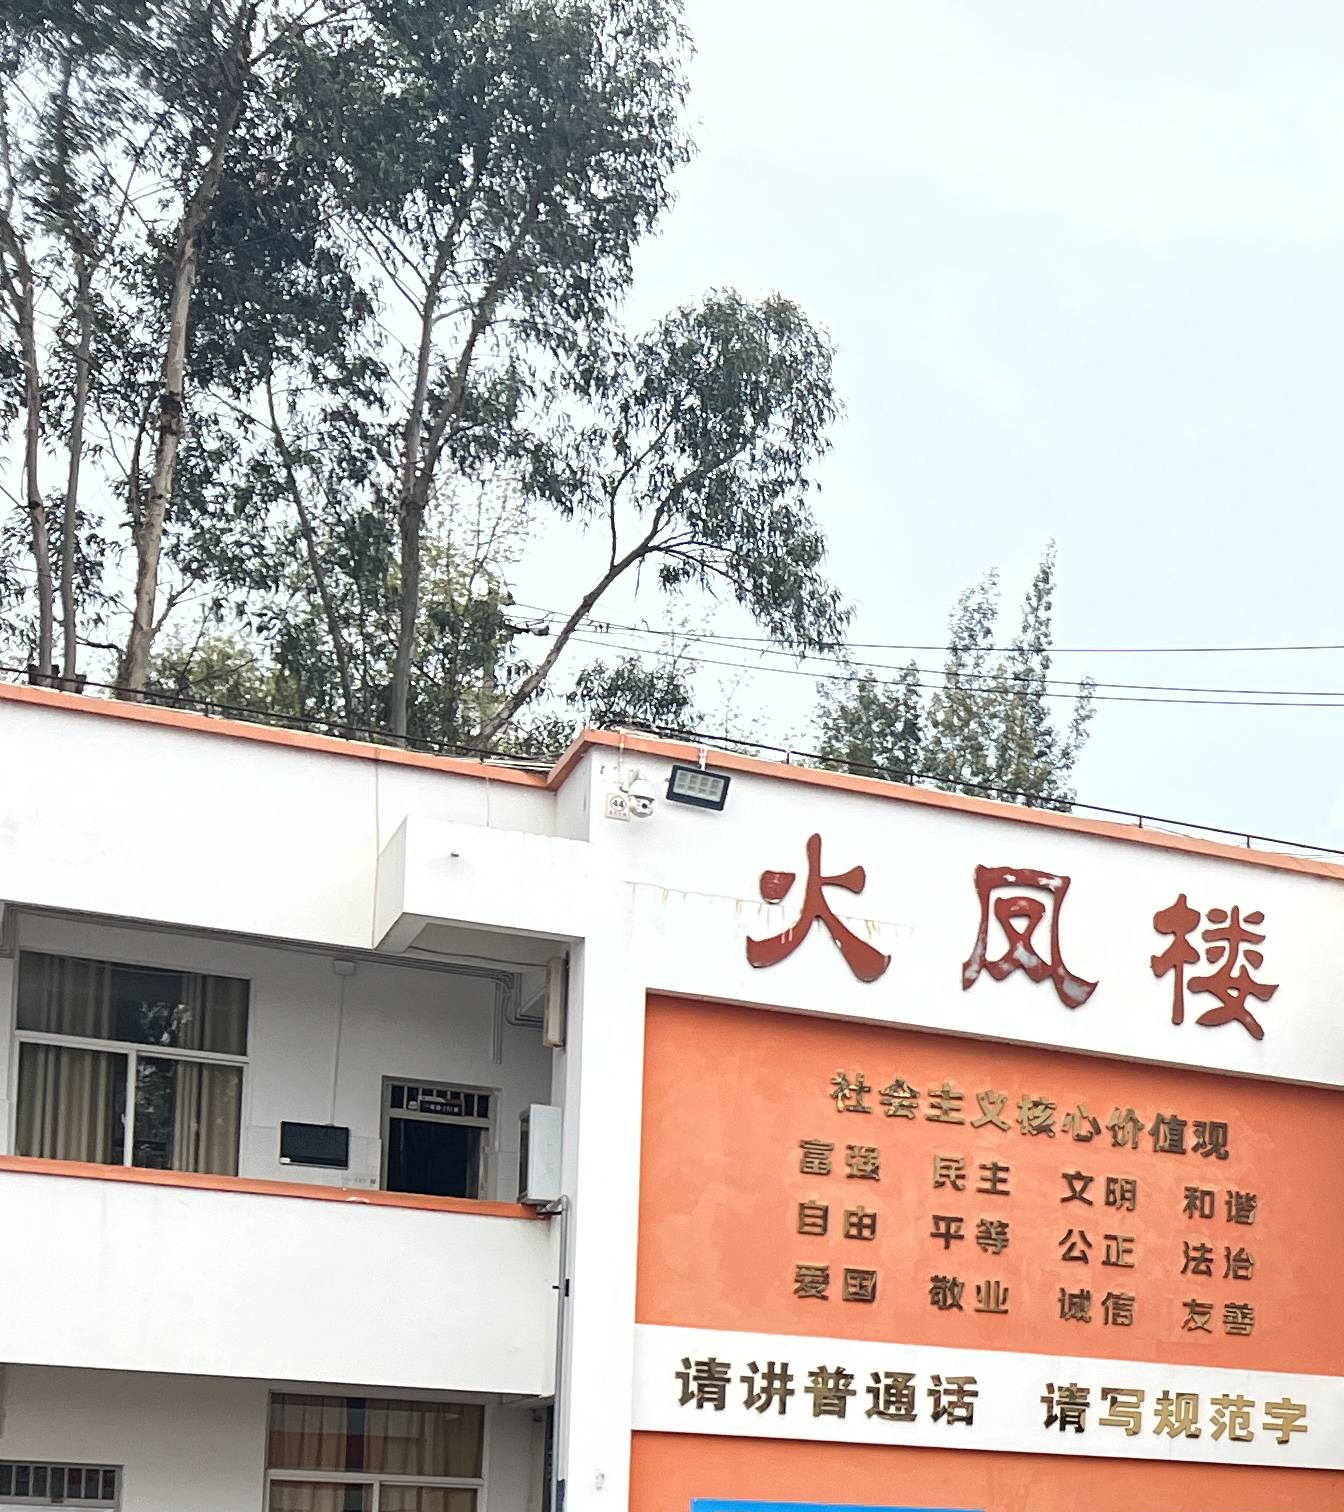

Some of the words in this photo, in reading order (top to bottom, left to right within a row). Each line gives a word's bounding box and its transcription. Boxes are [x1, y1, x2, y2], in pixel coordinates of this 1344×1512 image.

[746, 832, 1280, 1041] 火凤楼
[830, 1071, 1230, 1160] 社会主义核心价值观
[799, 1138, 881, 1182] 富强
[933, 1153, 1012, 1197] 民主
[1060, 1169, 1138, 1212] 文明
[1183, 1185, 1258, 1226] 和谐
[797, 1200, 877, 1241] 自由
[930, 1213, 1010, 1255] 平等
[1058, 1227, 1136, 1268] 公正
[1182, 1240, 1256, 1280] 法治
[794, 1262, 878, 1303] 爱国
[929, 1274, 1010, 1315] 敬业
[1057, 1286, 1136, 1328] 诚信
[1182, 1297, 1257, 1336] 友善
[674, 1355, 979, 1426] 请讲普通话
[1039, 1382, 1309, 1446] 请写规范字
